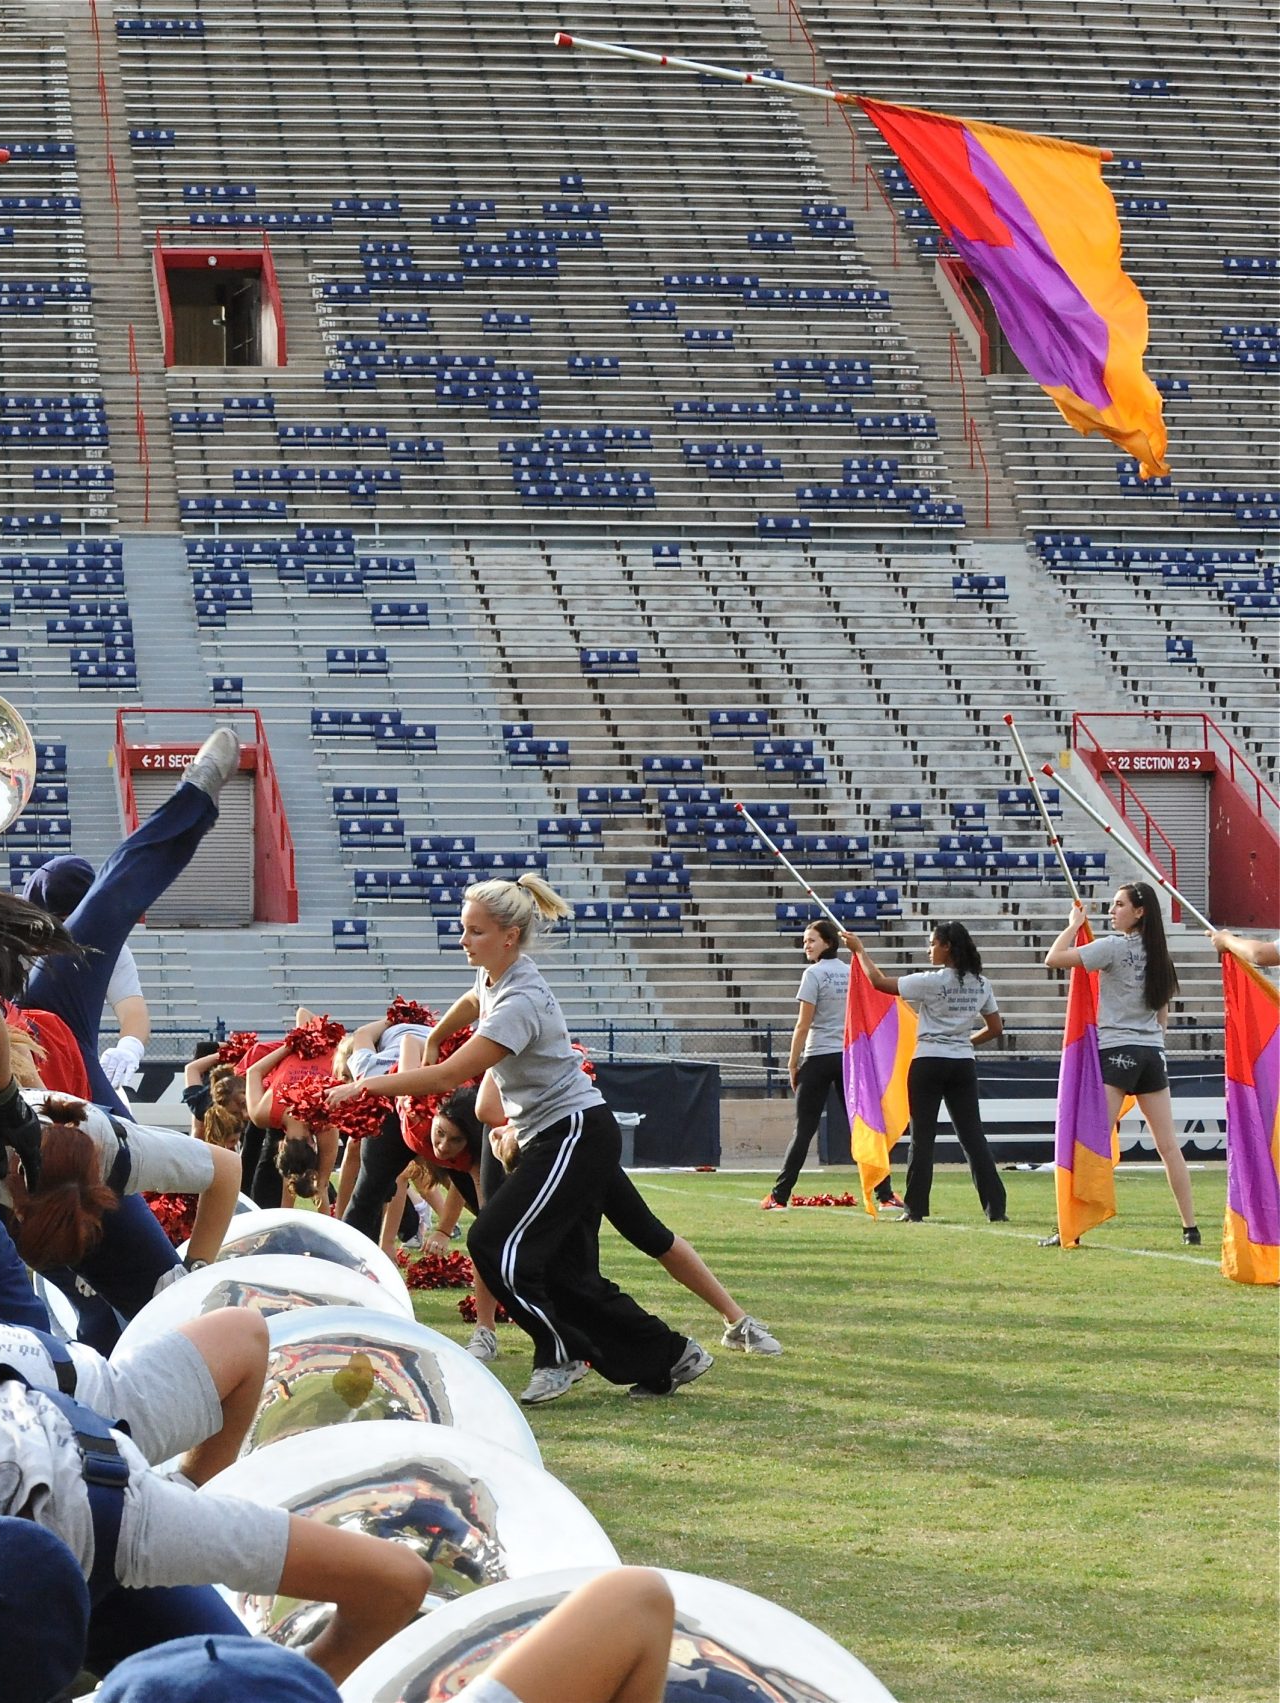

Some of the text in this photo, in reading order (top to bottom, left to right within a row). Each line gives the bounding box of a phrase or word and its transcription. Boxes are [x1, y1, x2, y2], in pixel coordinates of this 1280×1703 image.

[154, 754, 196, 768] 21 SECT
[1118, 757, 1190, 769] 22 SECTION 23
